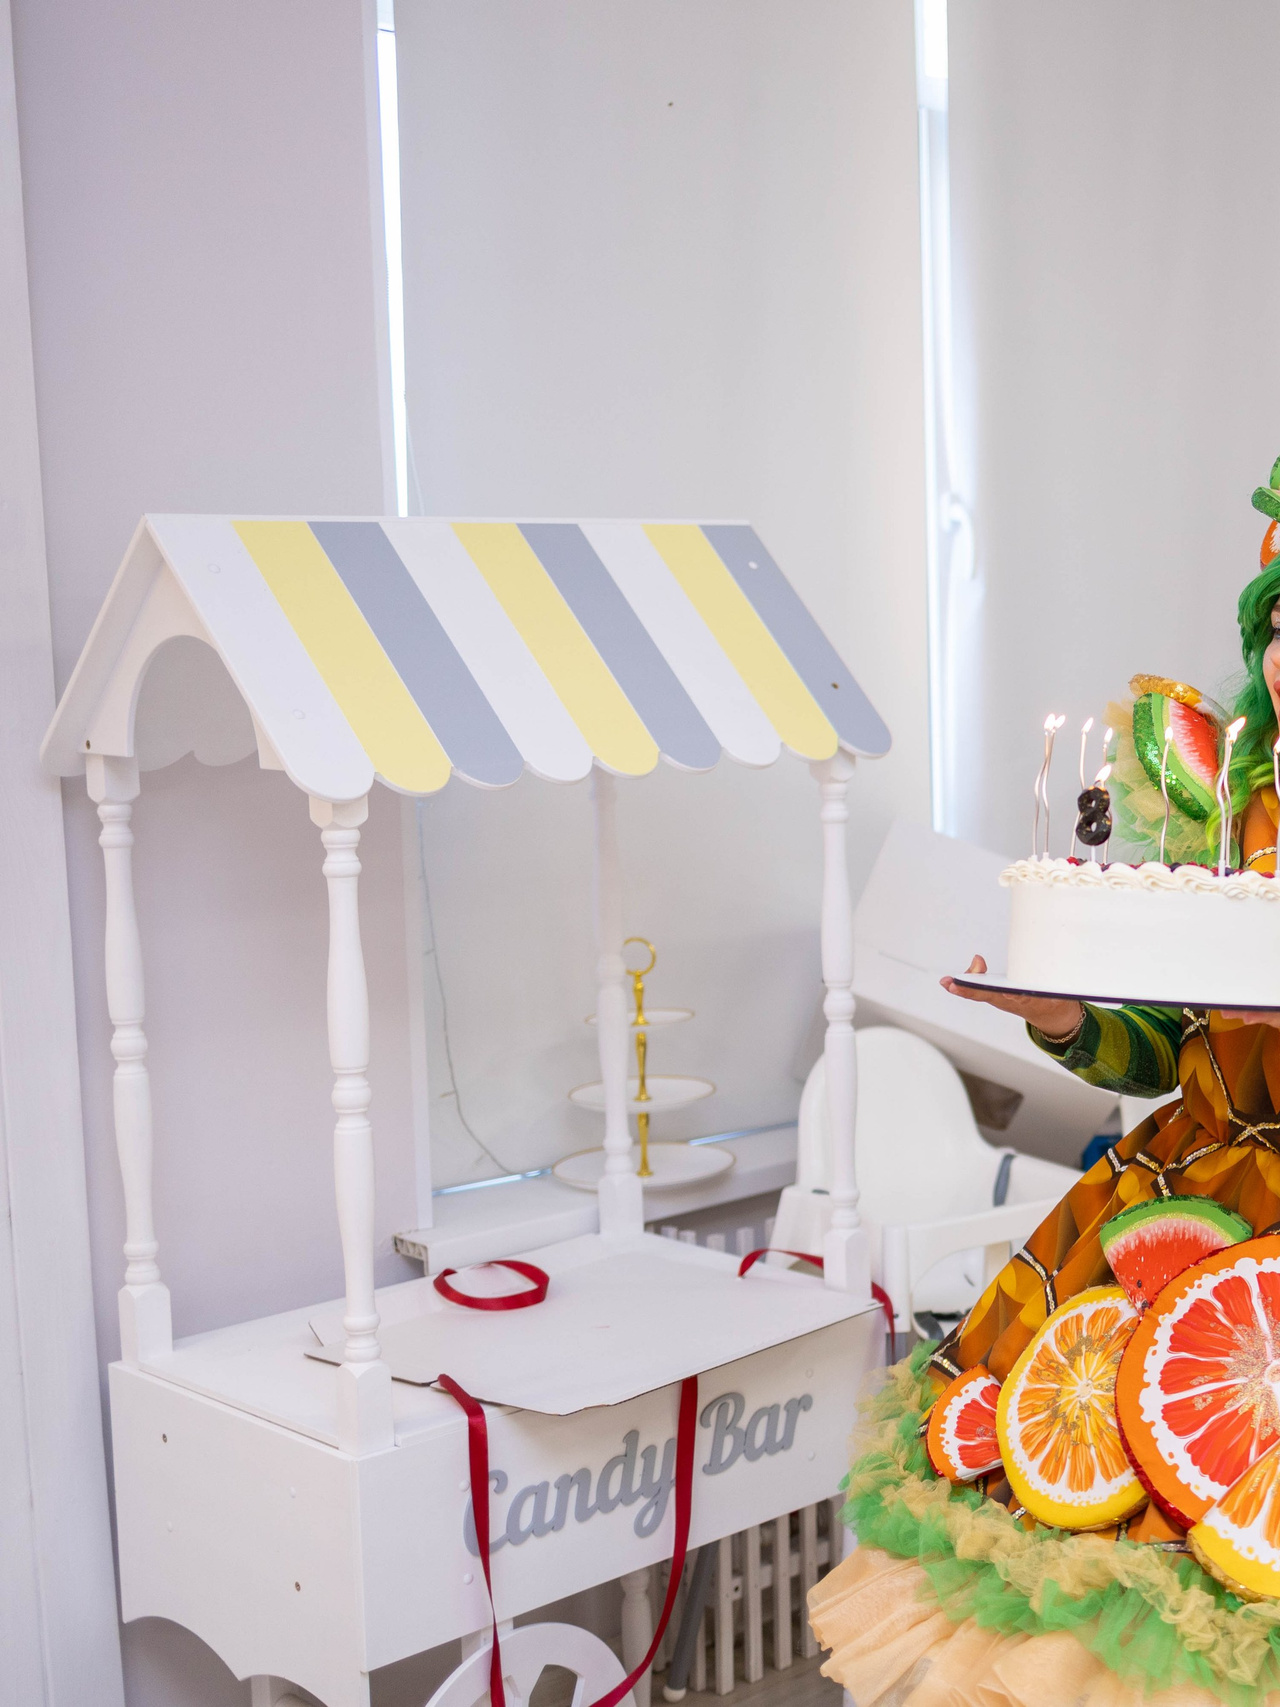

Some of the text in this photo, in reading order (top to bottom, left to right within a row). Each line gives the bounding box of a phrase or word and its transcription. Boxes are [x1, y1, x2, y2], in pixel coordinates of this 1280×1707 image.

[1075, 785, 1112, 846] 8
[463, 1391, 813, 1557] Candy Bar
